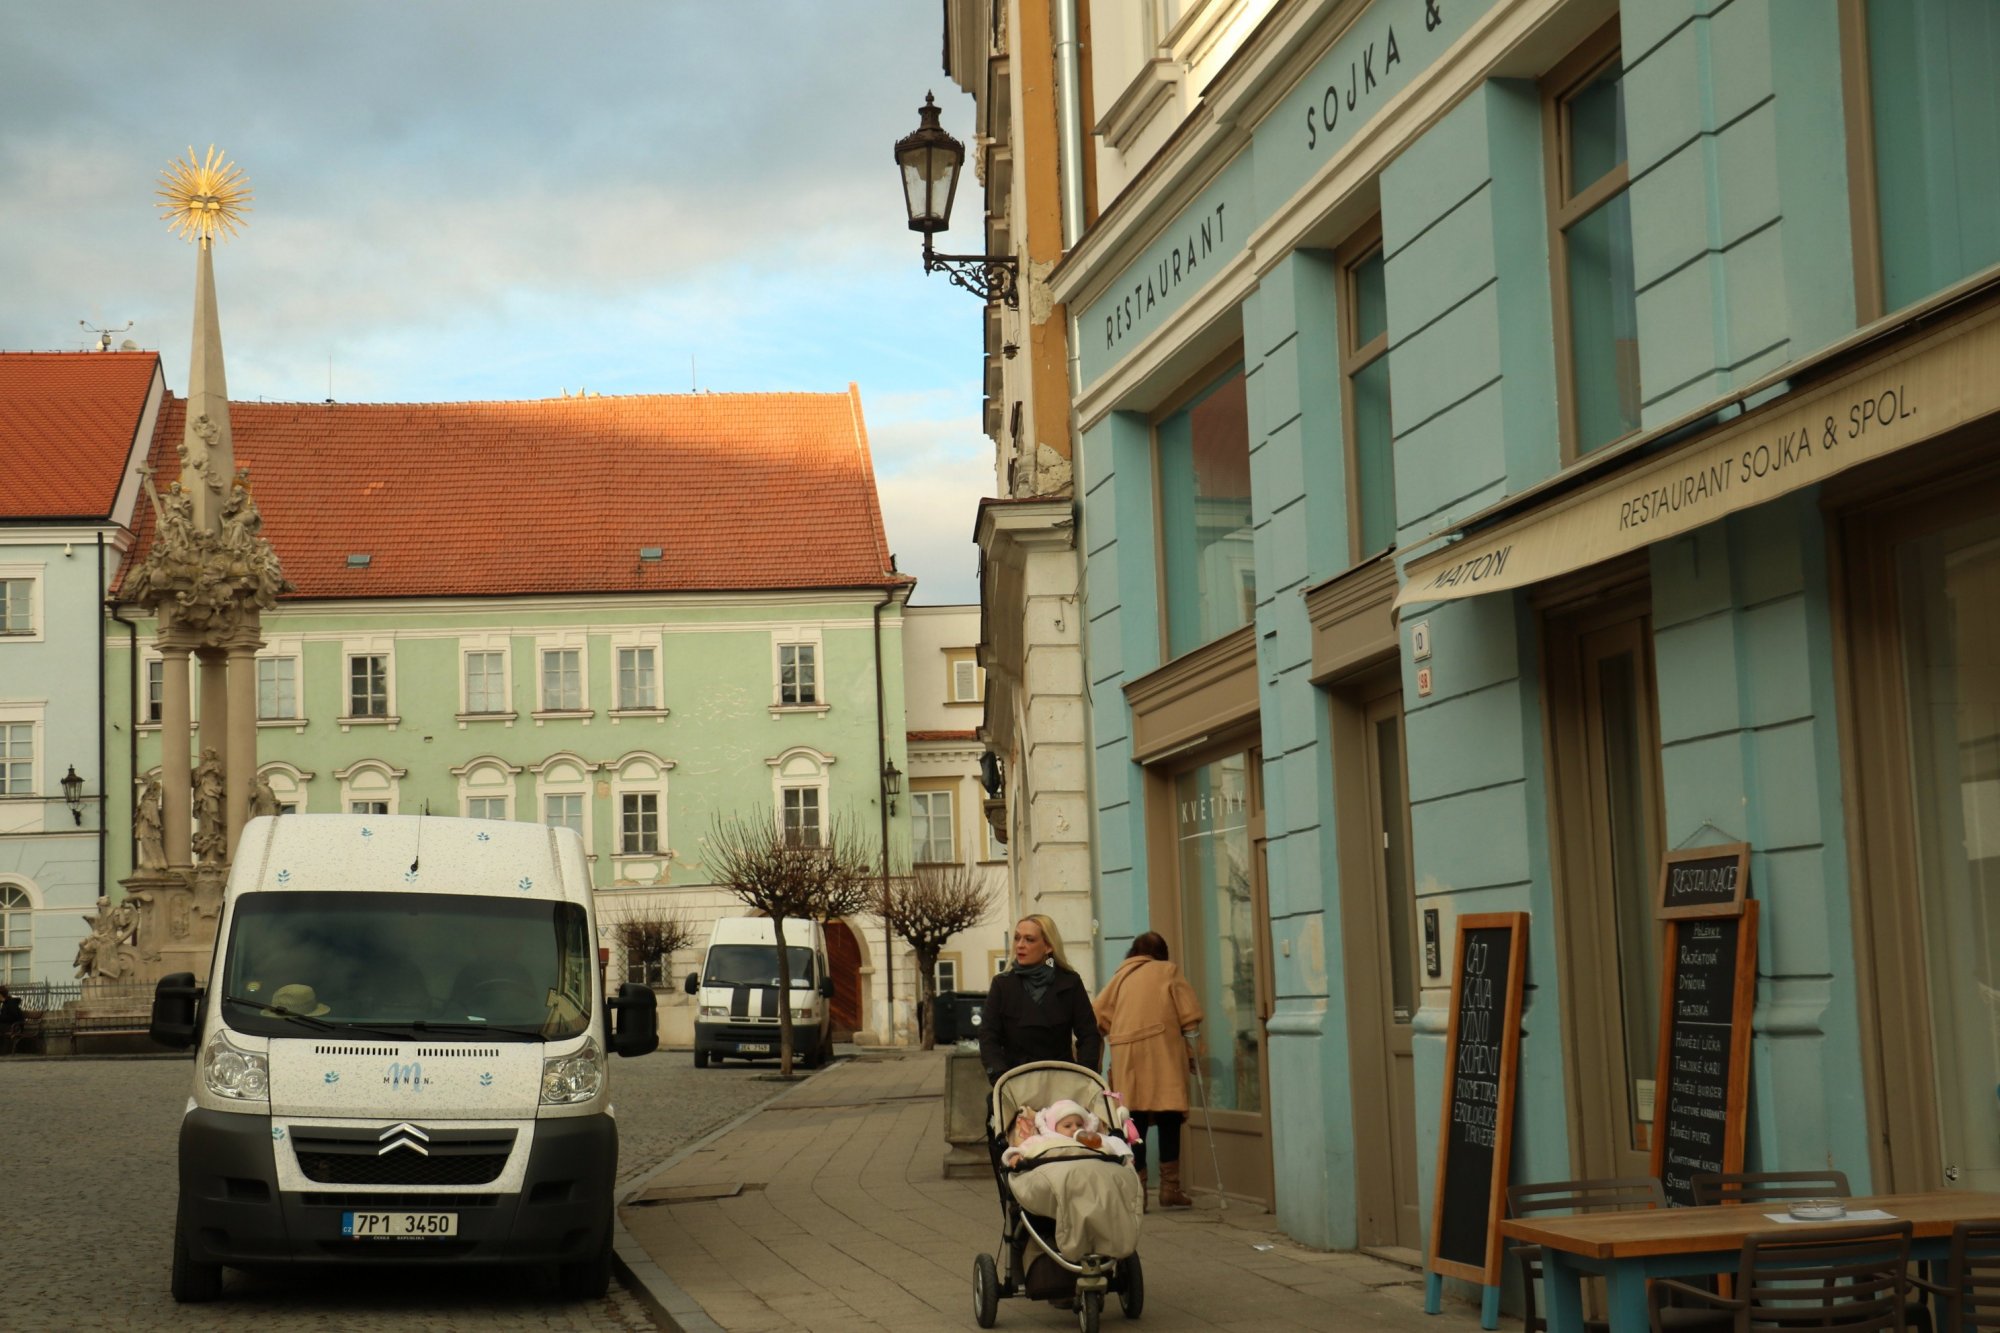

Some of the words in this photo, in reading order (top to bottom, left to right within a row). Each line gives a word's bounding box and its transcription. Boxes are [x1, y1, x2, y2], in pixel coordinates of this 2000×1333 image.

[1106, 202, 1225, 351] RESTAURANT
[1307, 24, 1401, 151] SOJKA
[1425, 0, 1442, 32] &
[1619, 458, 1733, 532] RESTAURANT
[1741, 427, 1812, 484] SOJKA
[1822, 415, 1839, 450] &
[1848, 384, 1918, 439] SPOL.
[1423, 545, 1512, 591] MATTONI
[1182, 790, 1244, 824] KVĚTINY
[1671, 865, 1739, 898] RESTAURACE
[357, 1214, 390, 1233] 7P1
[404, 1215, 450, 1234] 3450
